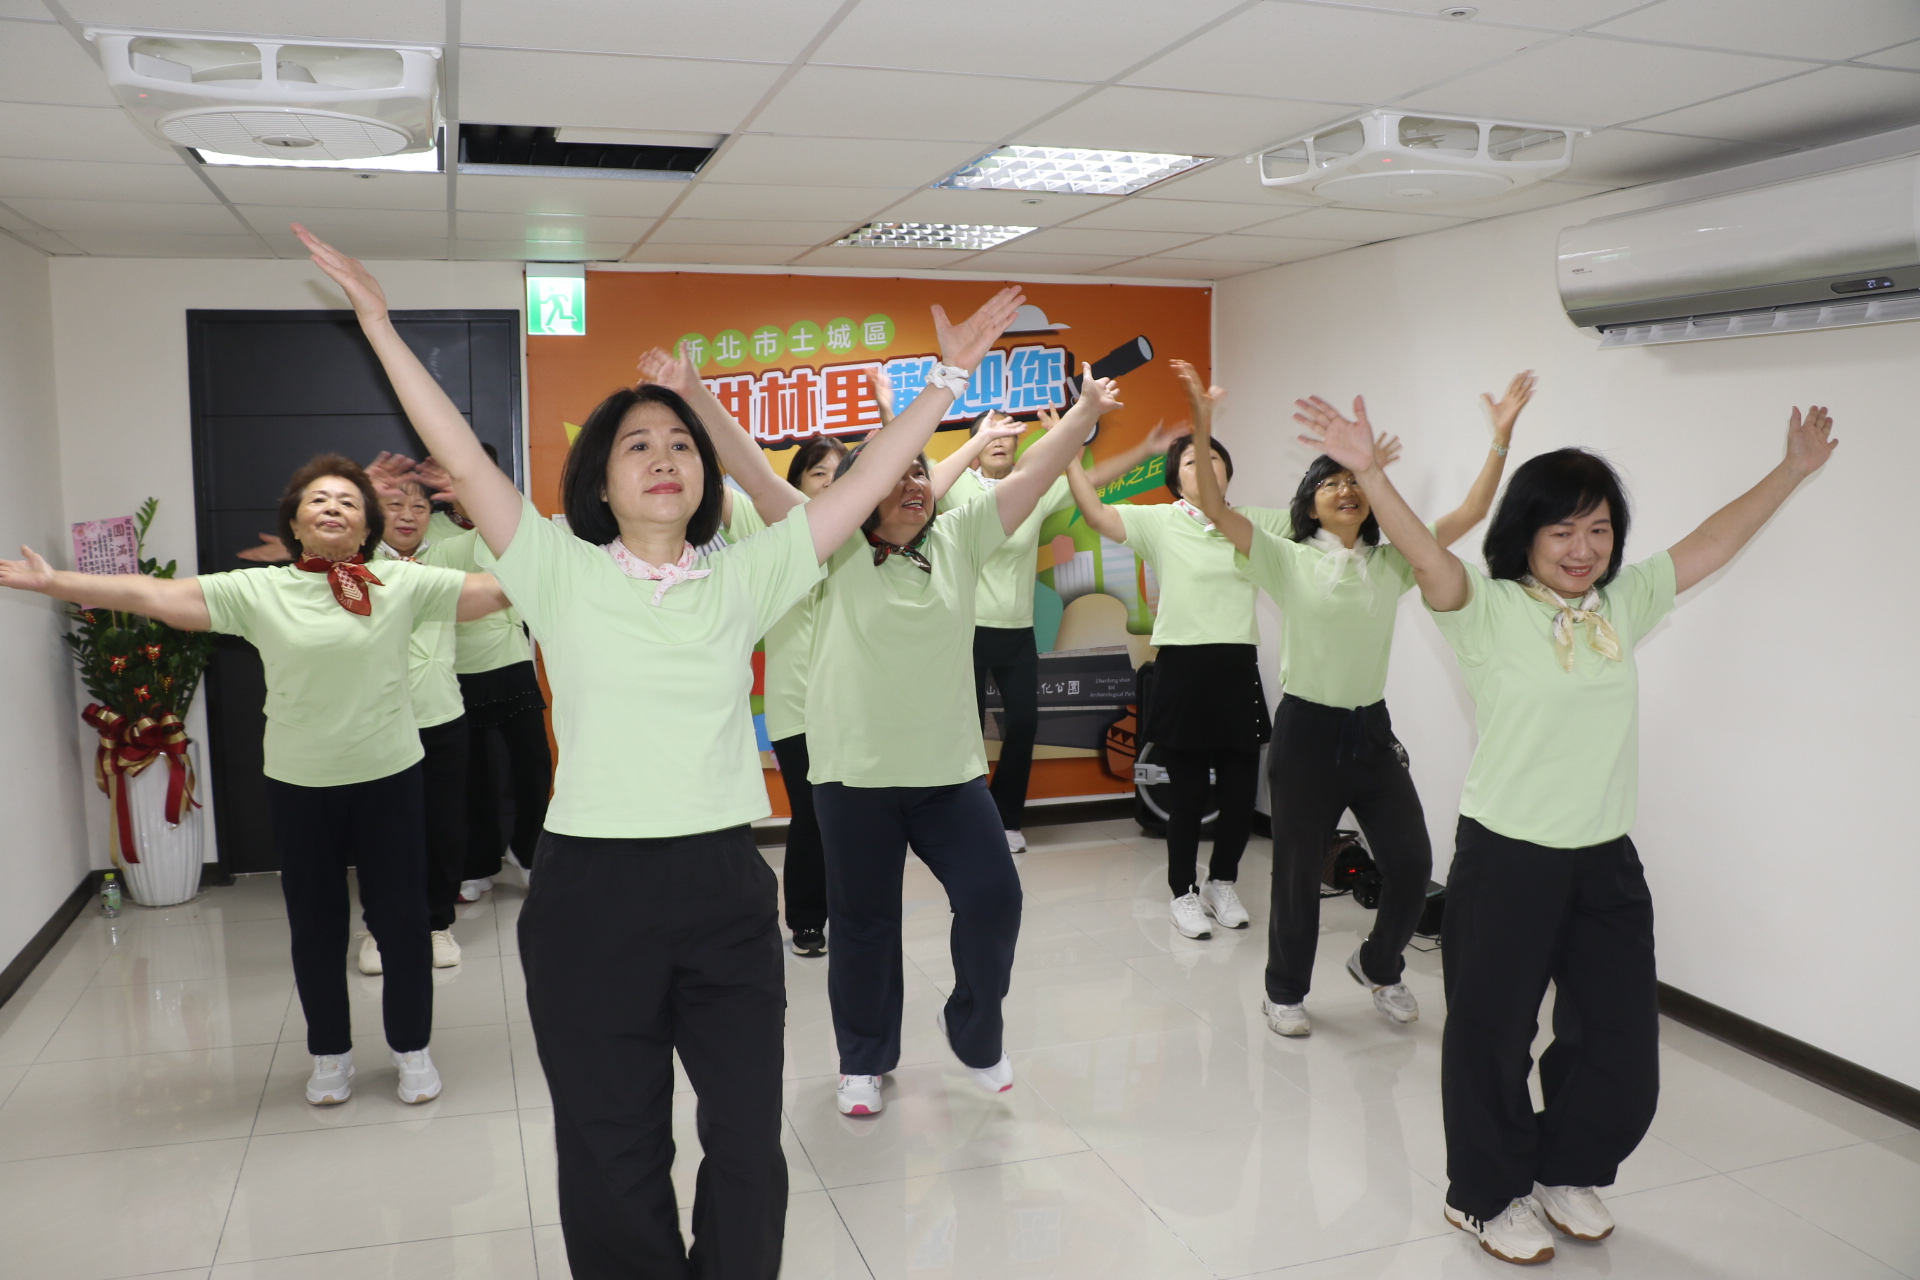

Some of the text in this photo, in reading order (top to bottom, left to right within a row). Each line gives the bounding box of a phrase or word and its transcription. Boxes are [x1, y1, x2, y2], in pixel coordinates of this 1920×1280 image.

[678, 320, 887, 365] 新北市土城區
